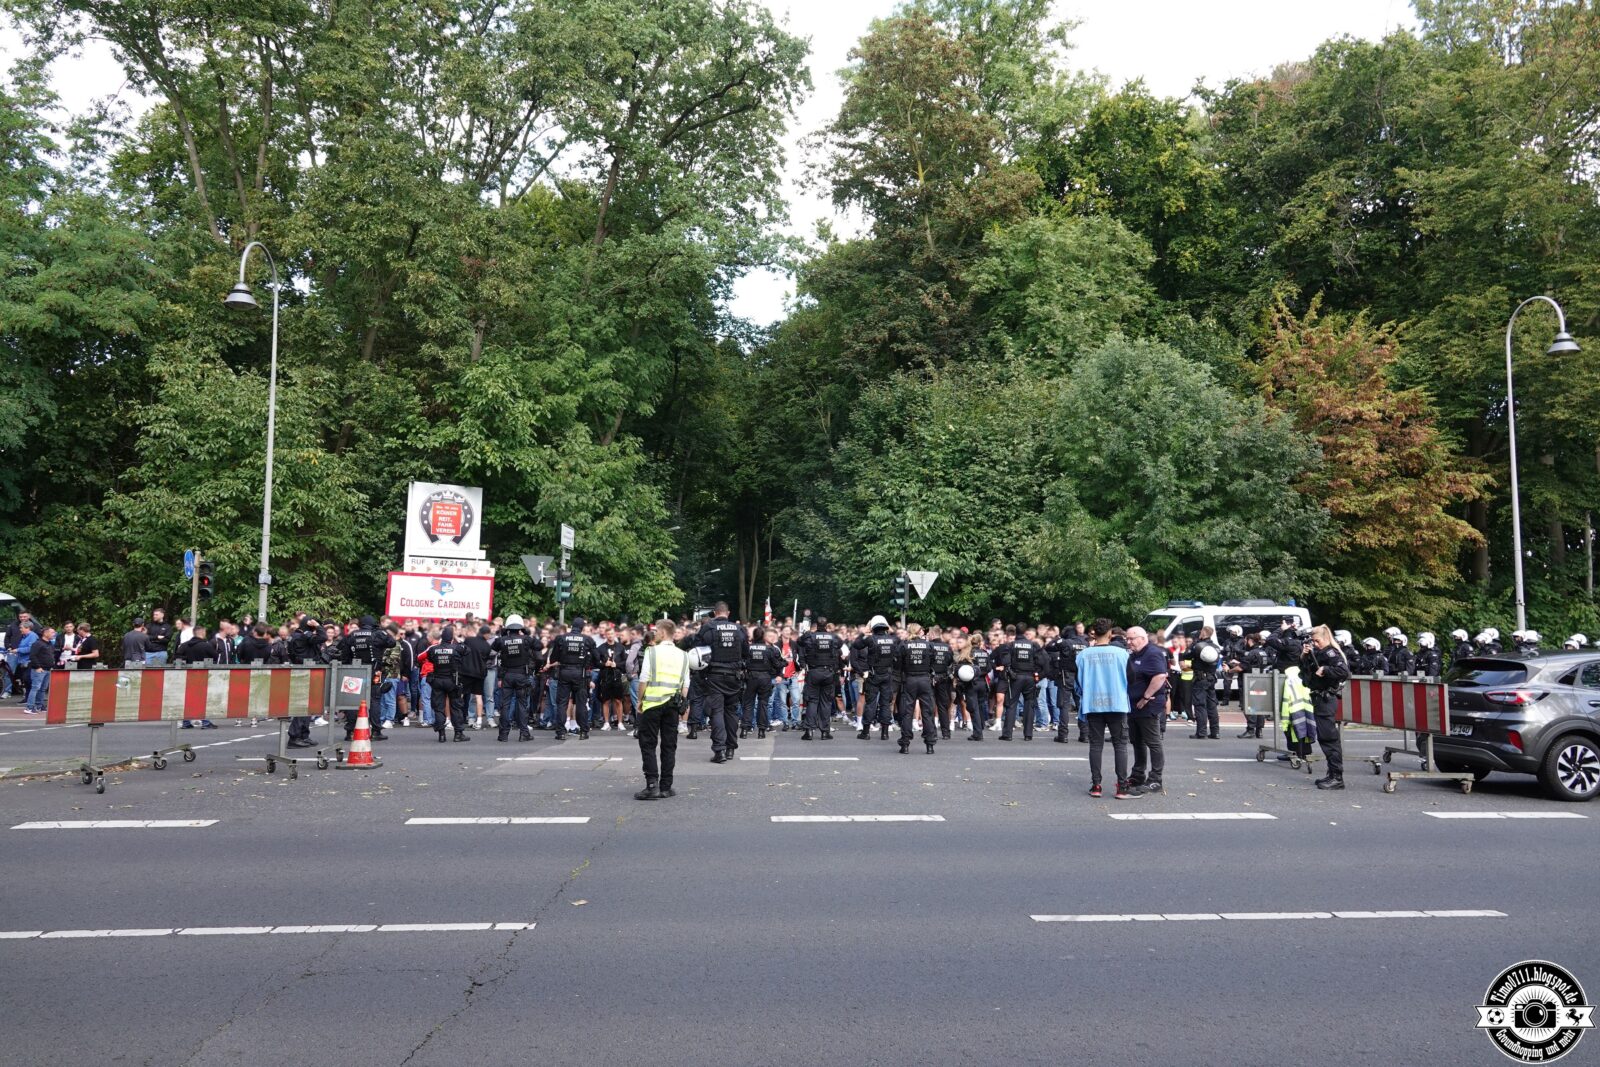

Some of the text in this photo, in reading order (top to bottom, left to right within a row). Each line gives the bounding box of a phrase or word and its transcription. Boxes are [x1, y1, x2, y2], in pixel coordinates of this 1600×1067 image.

[400, 597, 480, 610] COLOGNE CARDINALS
[716, 623, 738, 631] POLIZEI
[504, 638, 523, 646] POLIZEI
